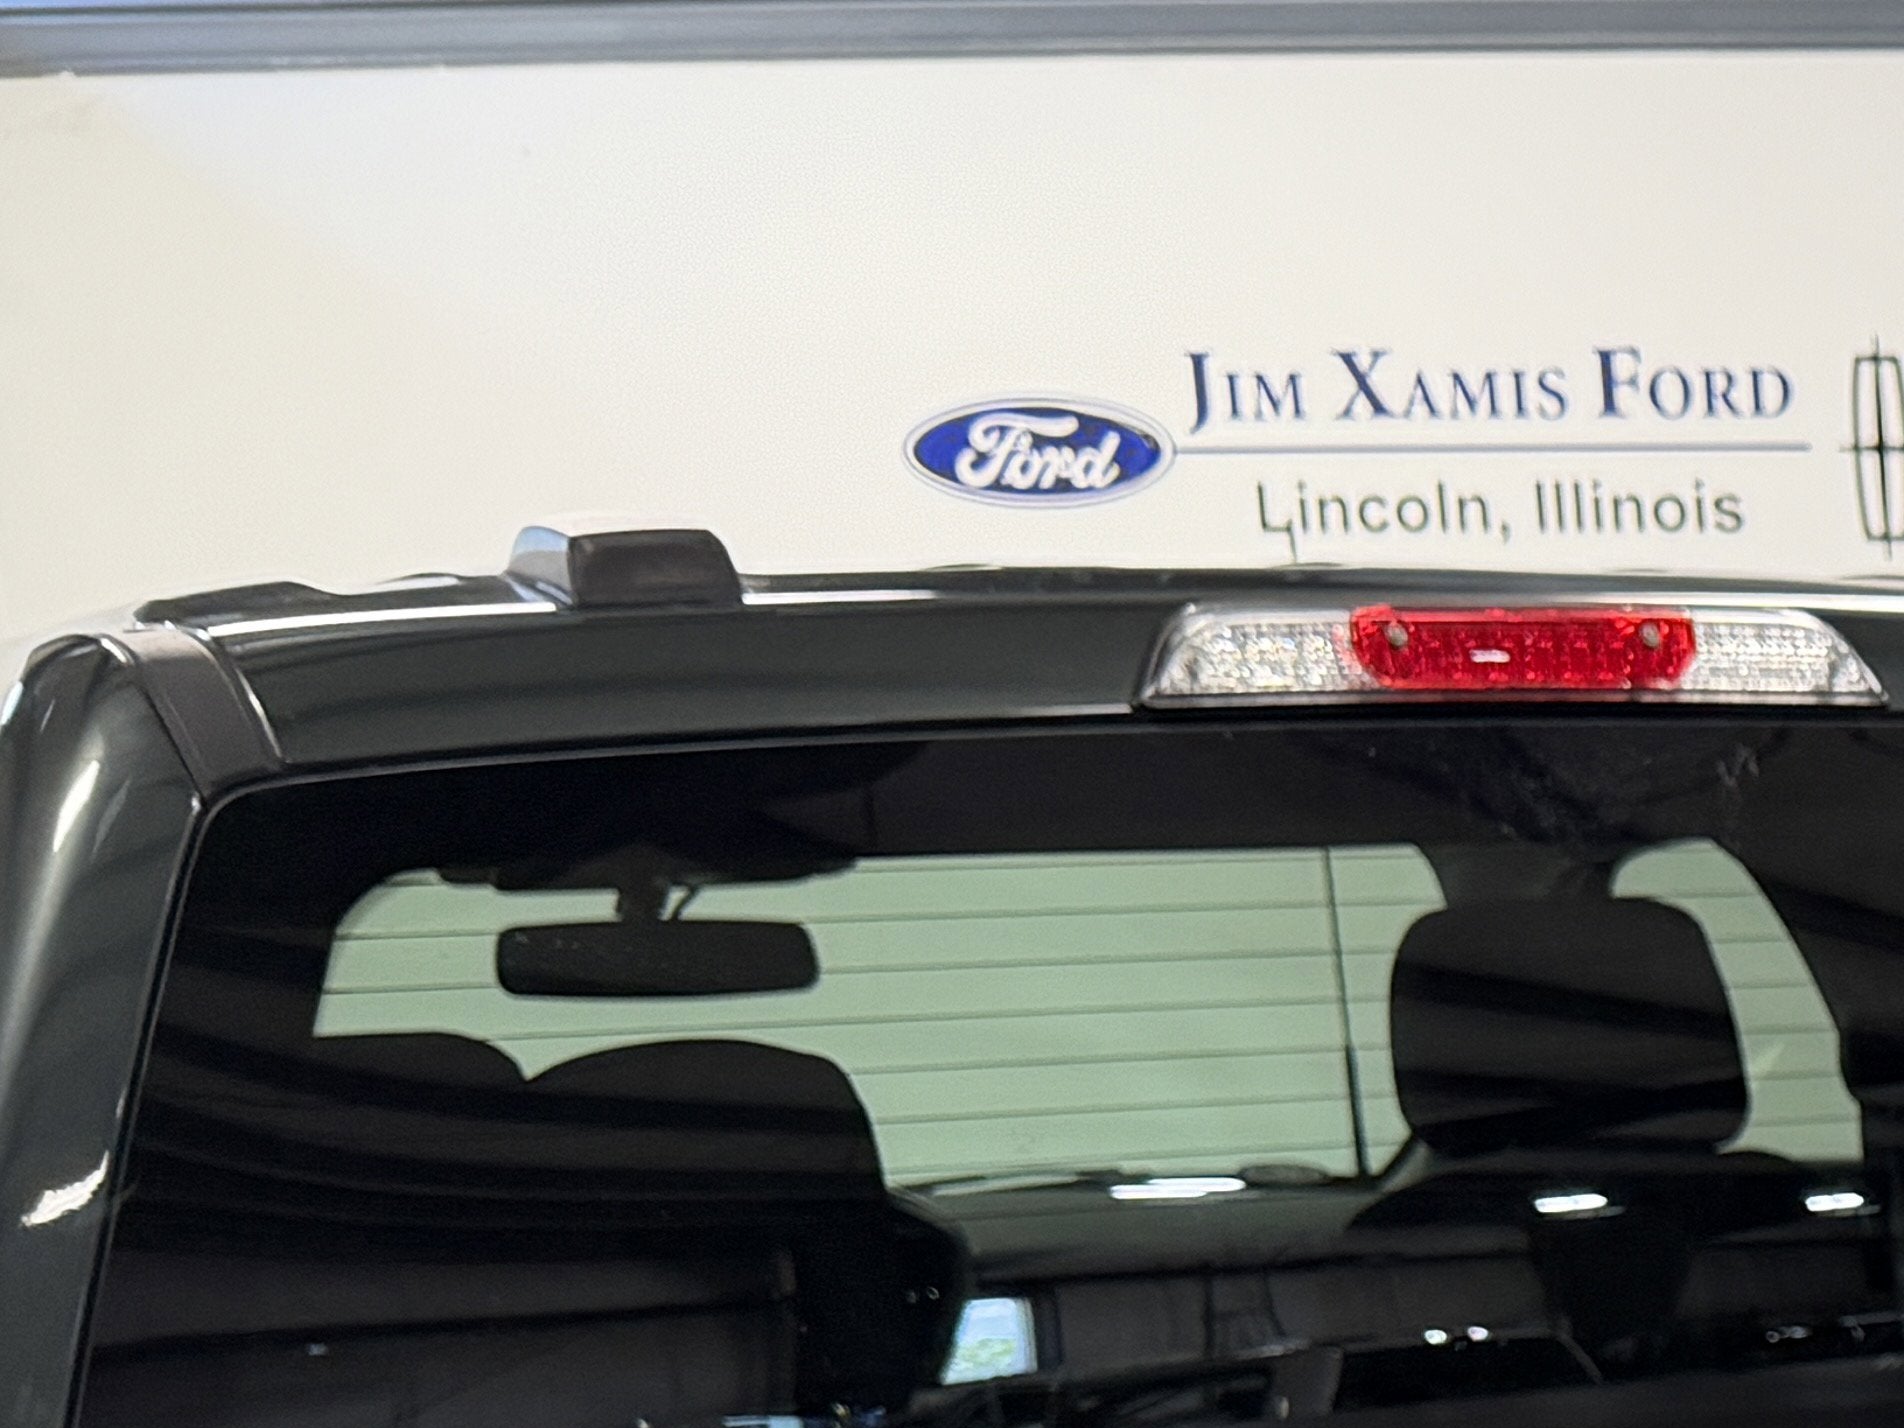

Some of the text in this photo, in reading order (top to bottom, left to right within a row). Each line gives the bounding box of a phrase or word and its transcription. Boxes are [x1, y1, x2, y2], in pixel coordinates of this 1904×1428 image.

[1333, 349, 1569, 421] XAMIS
[1593, 347, 1792, 419] FORD
[956, 413, 1119, 491] Ford
[1259, 480, 1743, 544] Lincoln, Illinois
